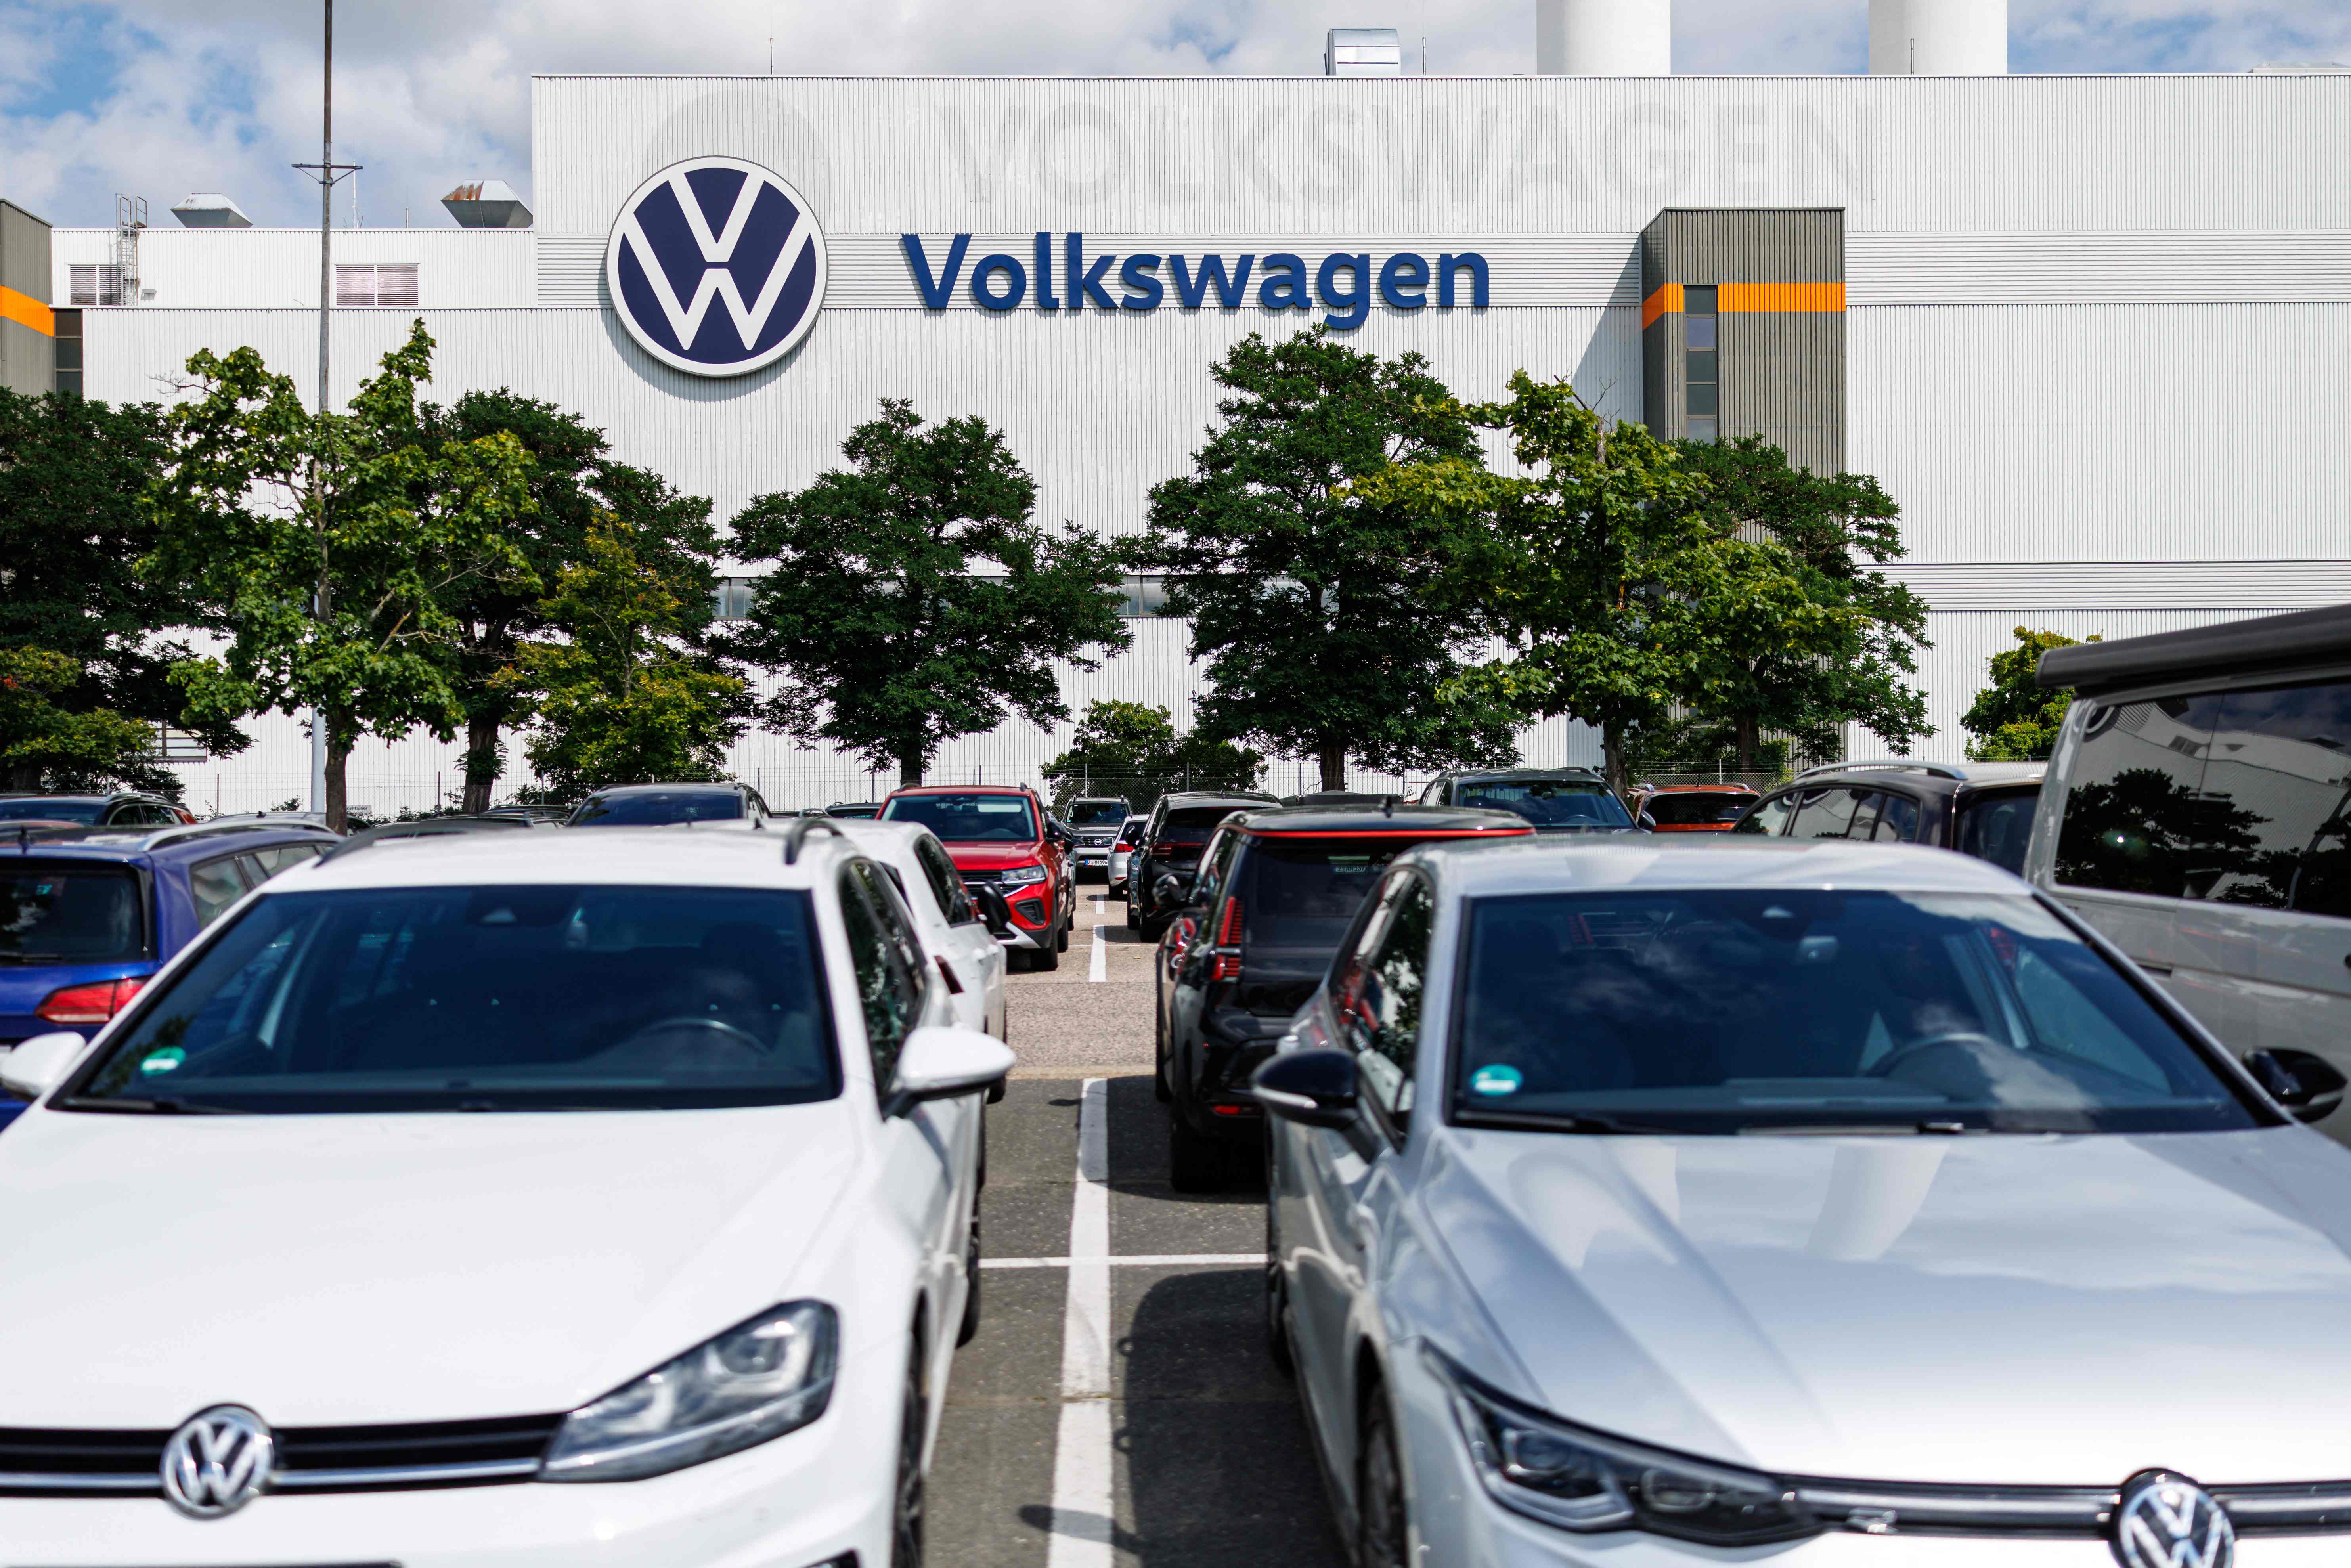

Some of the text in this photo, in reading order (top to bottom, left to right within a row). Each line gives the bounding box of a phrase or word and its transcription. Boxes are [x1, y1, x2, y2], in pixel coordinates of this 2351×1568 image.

[934, 104, 1877, 205] VOLKSWAGEN
[610, 160, 823, 361] VW
[903, 232, 1489, 329] Volkswagen
[168, 1413, 268, 1510] VW
